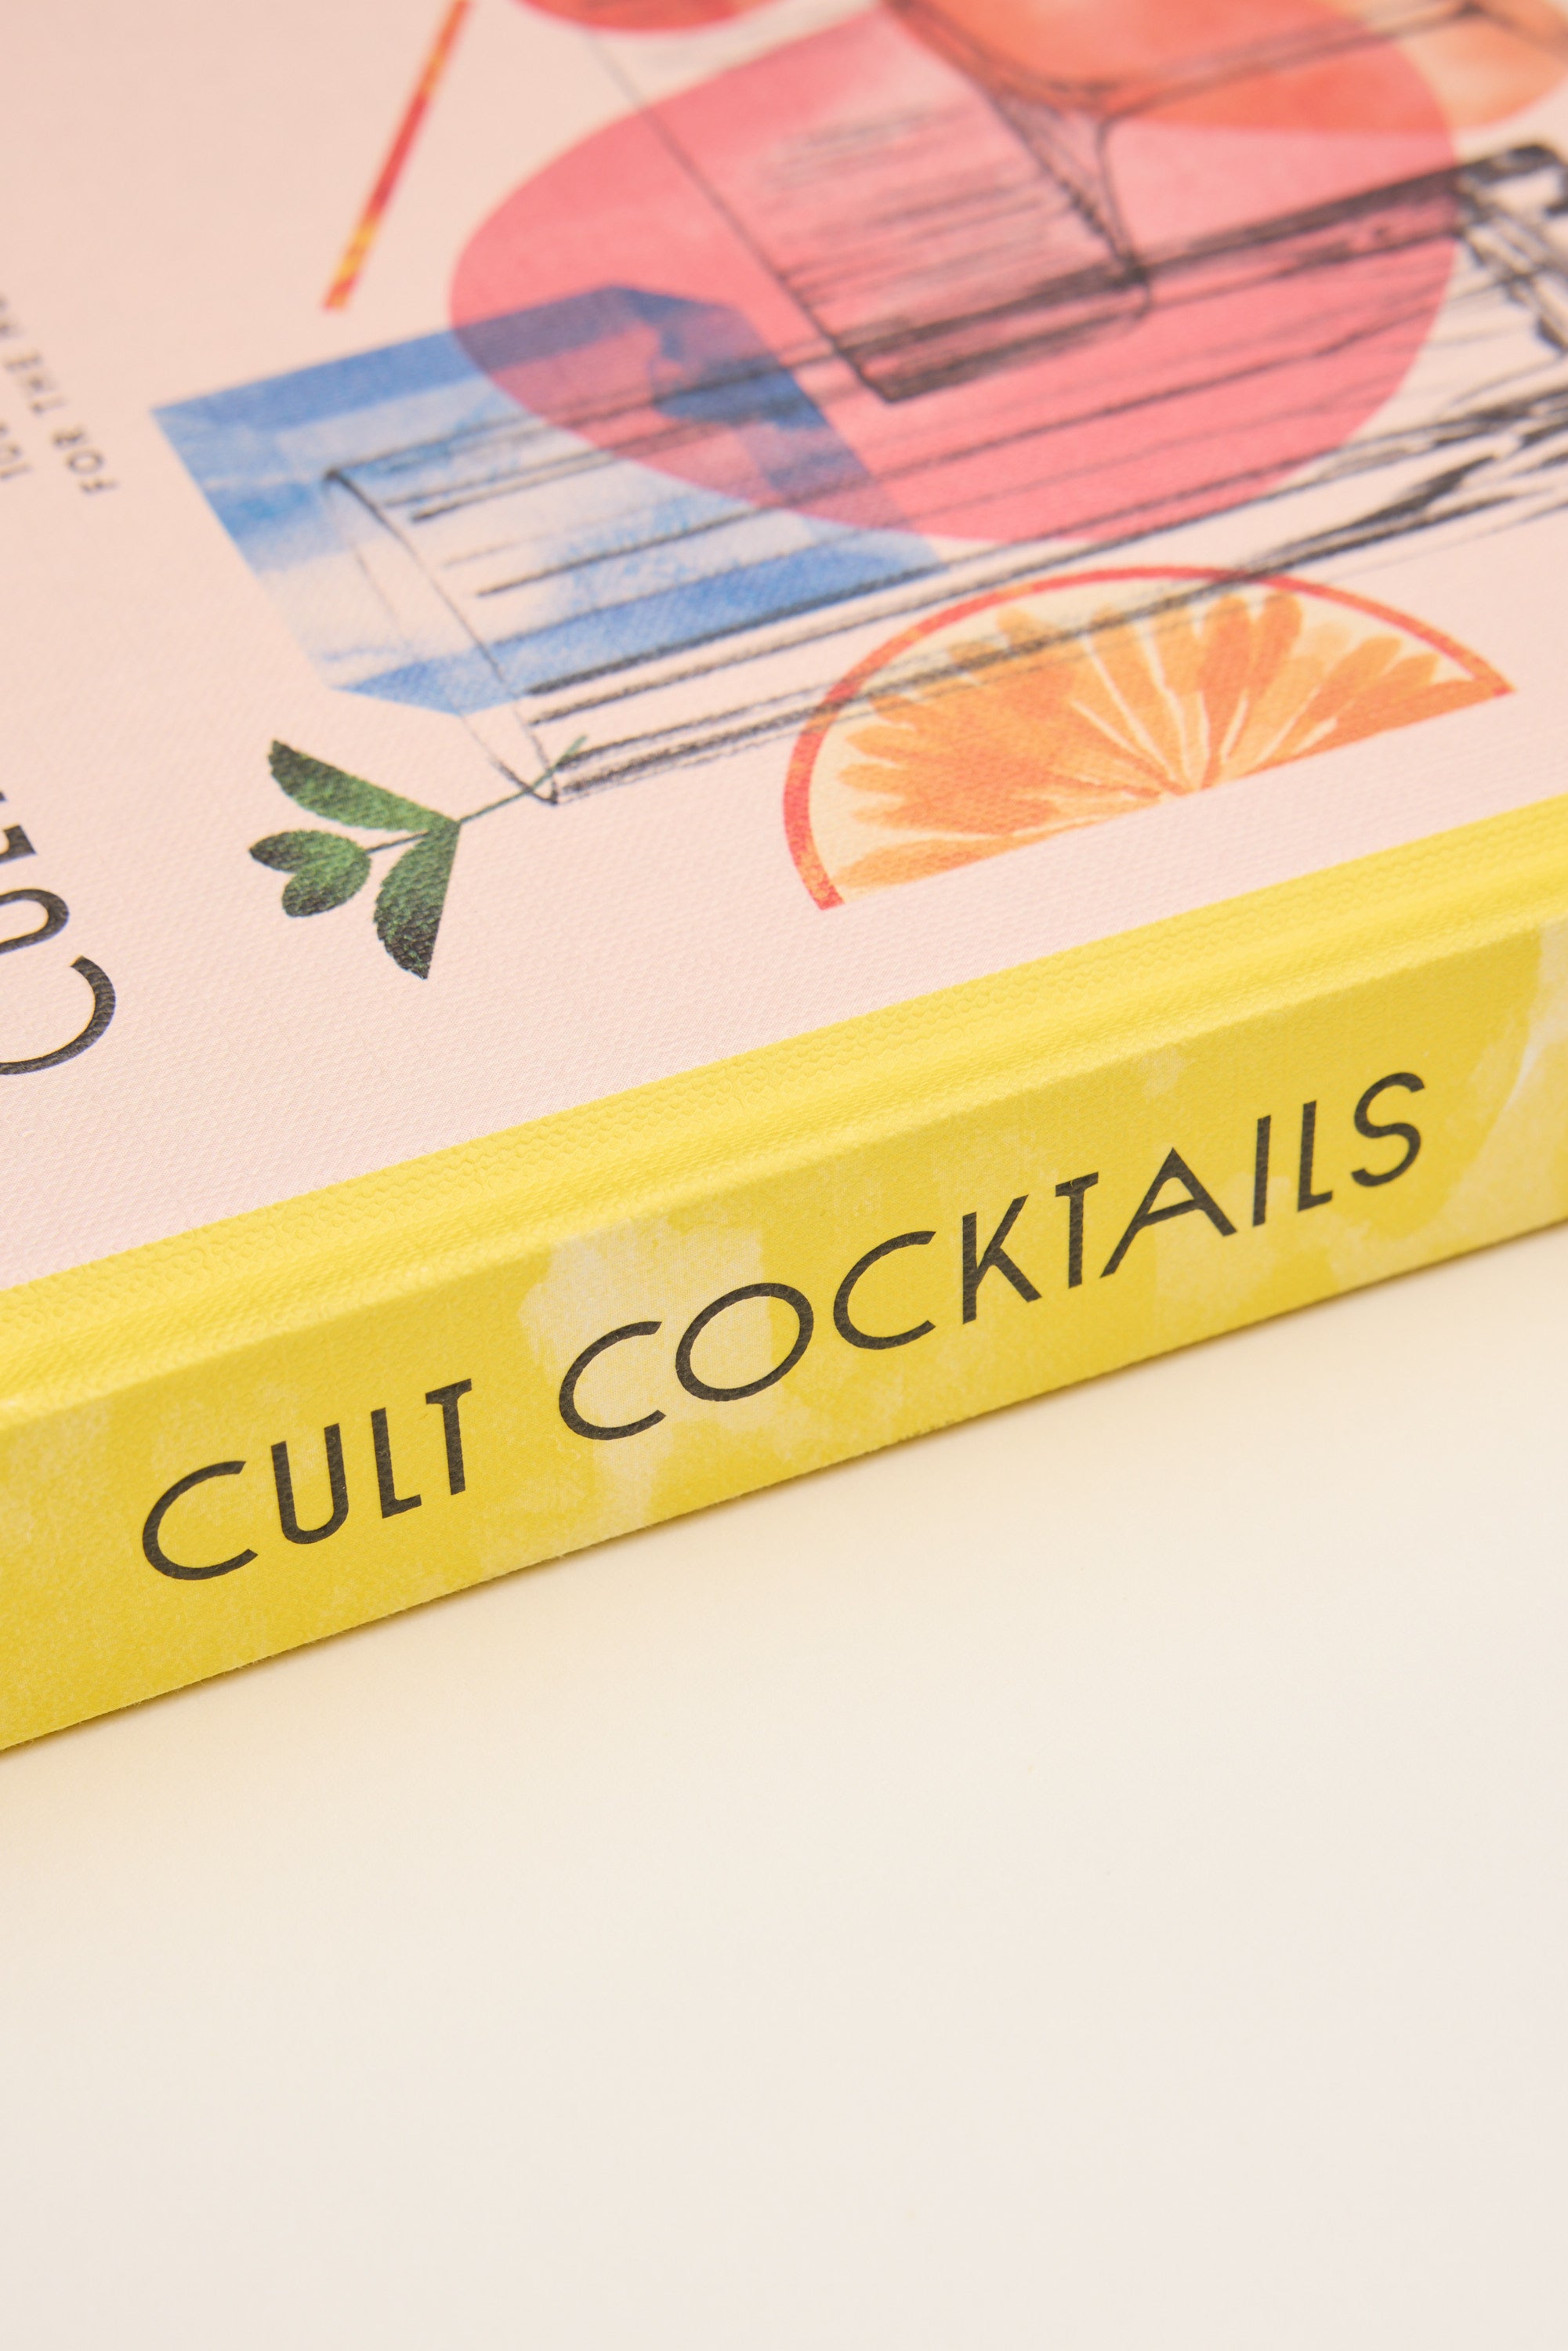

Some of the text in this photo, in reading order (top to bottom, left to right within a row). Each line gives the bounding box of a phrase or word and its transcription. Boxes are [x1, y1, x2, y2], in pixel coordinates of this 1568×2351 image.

[3, 350, 119, 494] FOR THE
[142, 1072, 1426, 1581] CULT COCKTAILS
